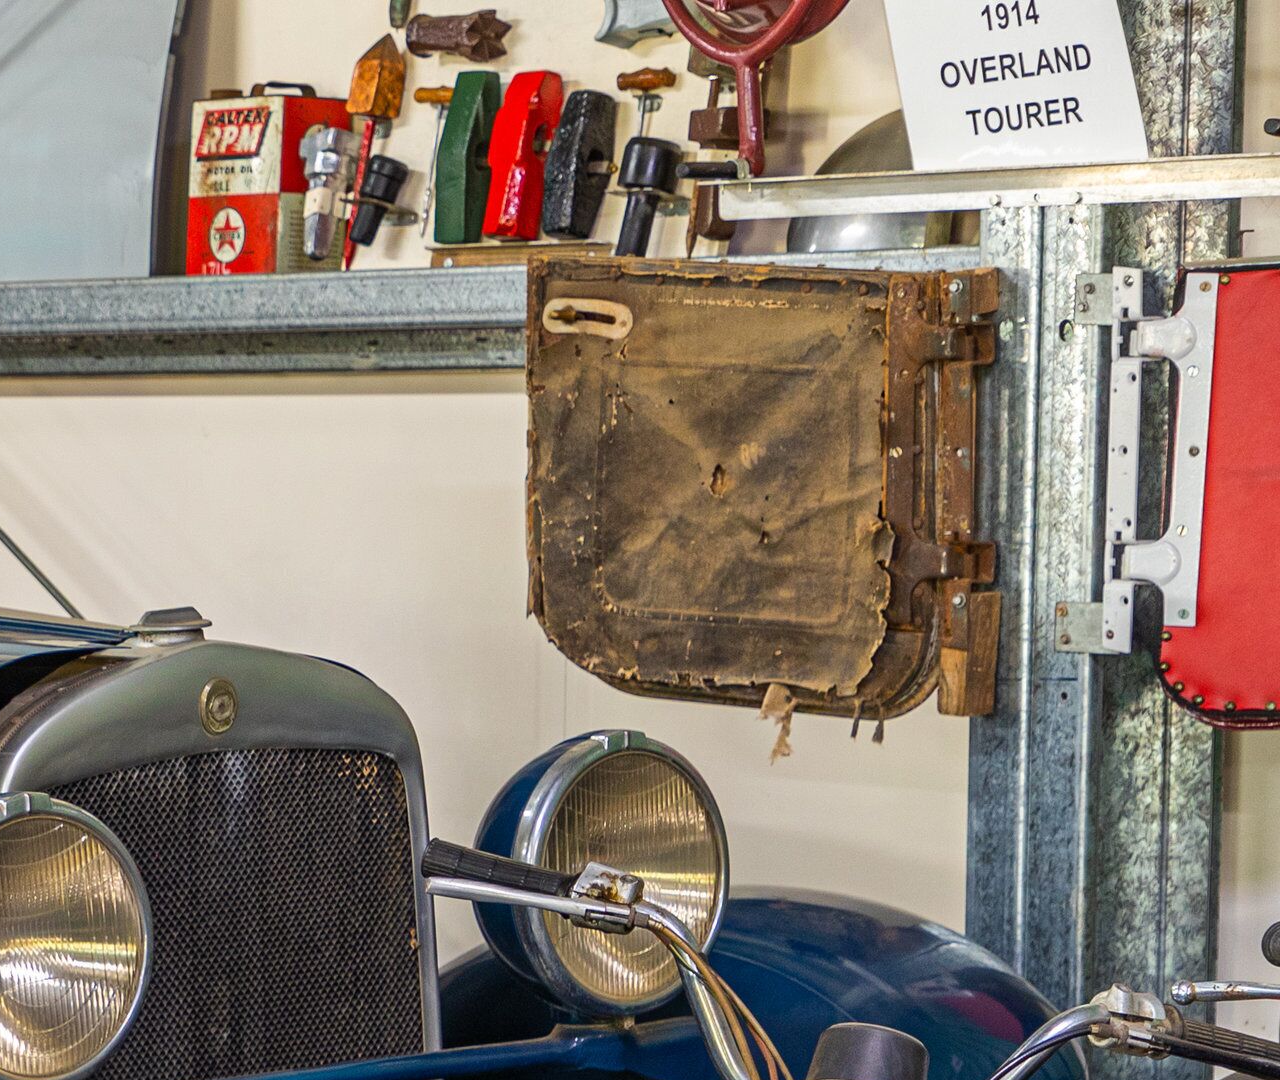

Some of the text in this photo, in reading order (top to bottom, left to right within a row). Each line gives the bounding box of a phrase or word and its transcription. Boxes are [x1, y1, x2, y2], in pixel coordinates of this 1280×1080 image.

[980, 0, 1041, 33] 1914
[940, 43, 1092, 89] OVERLAND
[206, 109, 264, 126] CALTEX
[965, 96, 1083, 136] TOURER
[202, 126, 263, 153] RPM
